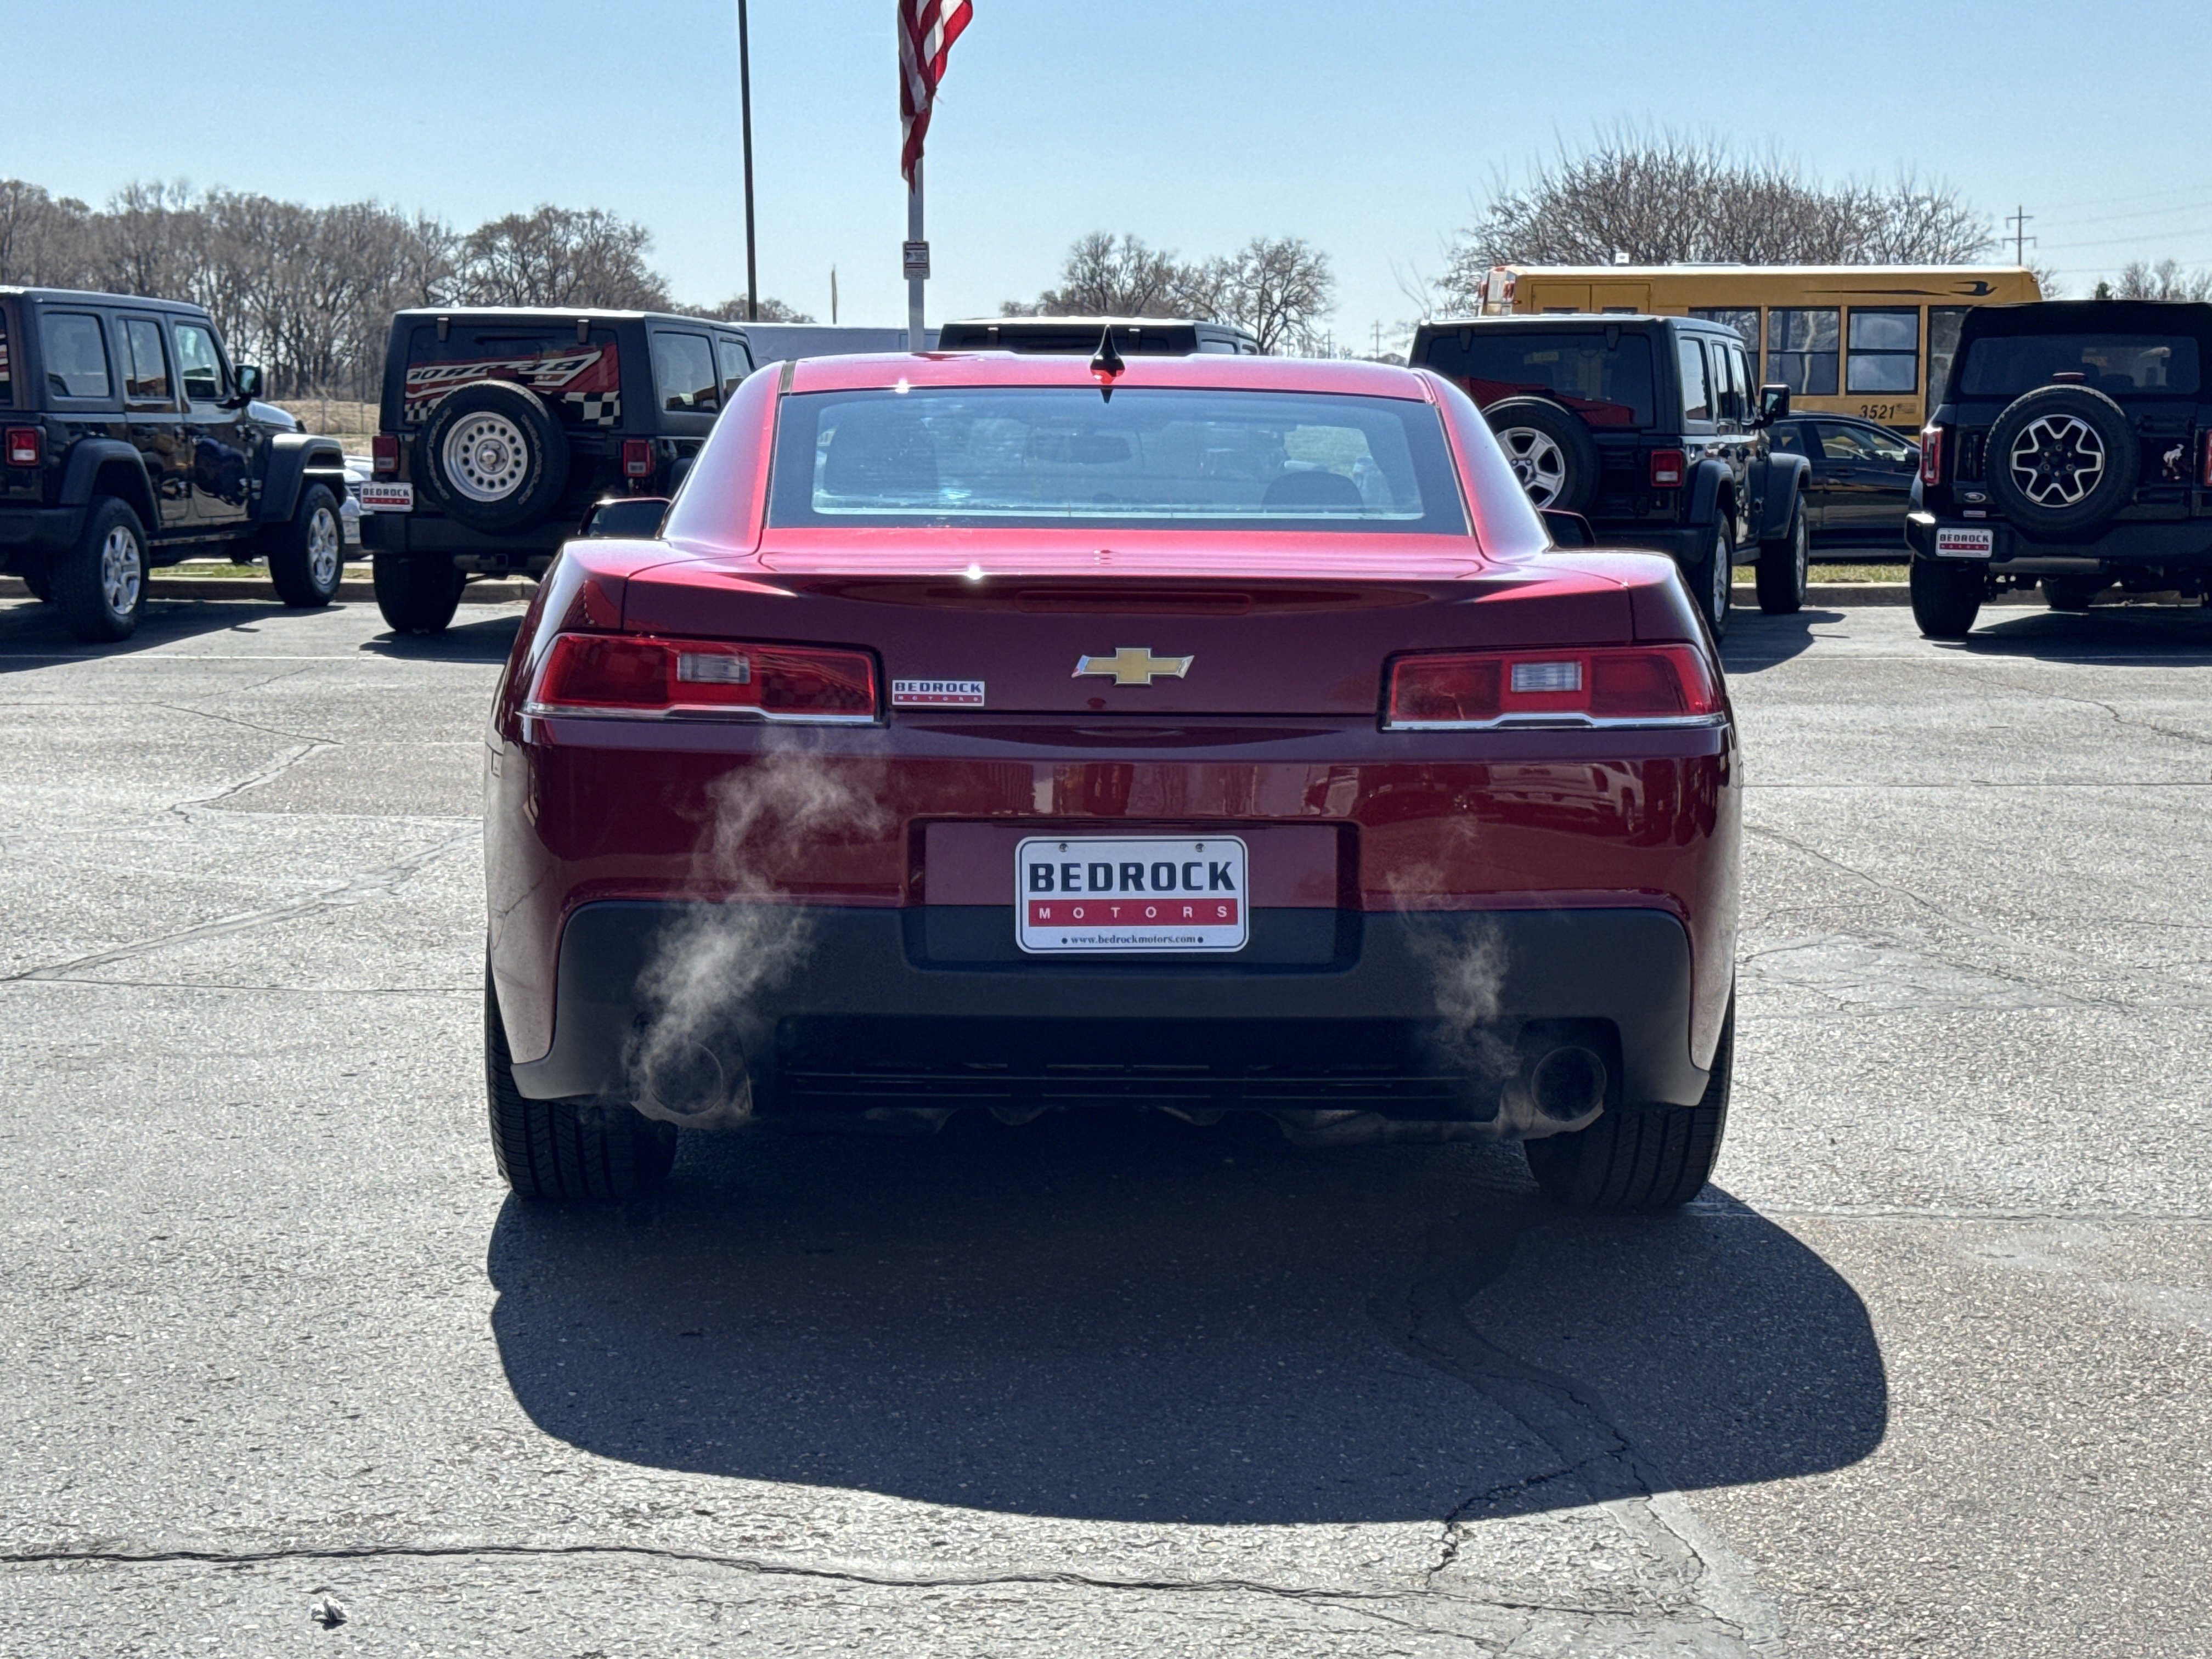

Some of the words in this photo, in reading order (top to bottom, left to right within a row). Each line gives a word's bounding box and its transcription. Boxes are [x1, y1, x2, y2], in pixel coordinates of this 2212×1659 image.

[1859, 404, 1895, 419] 3521
[363, 488, 409, 496] BEDROCK
[1939, 534, 1989, 543] BEDROCK
[895, 682, 981, 693] BEDROCK
[1028, 861, 1236, 892] BEDROCK
[1039, 905, 1228, 919] MOTORS
[1070, 934, 1196, 945] www.bedrockmotors.com
